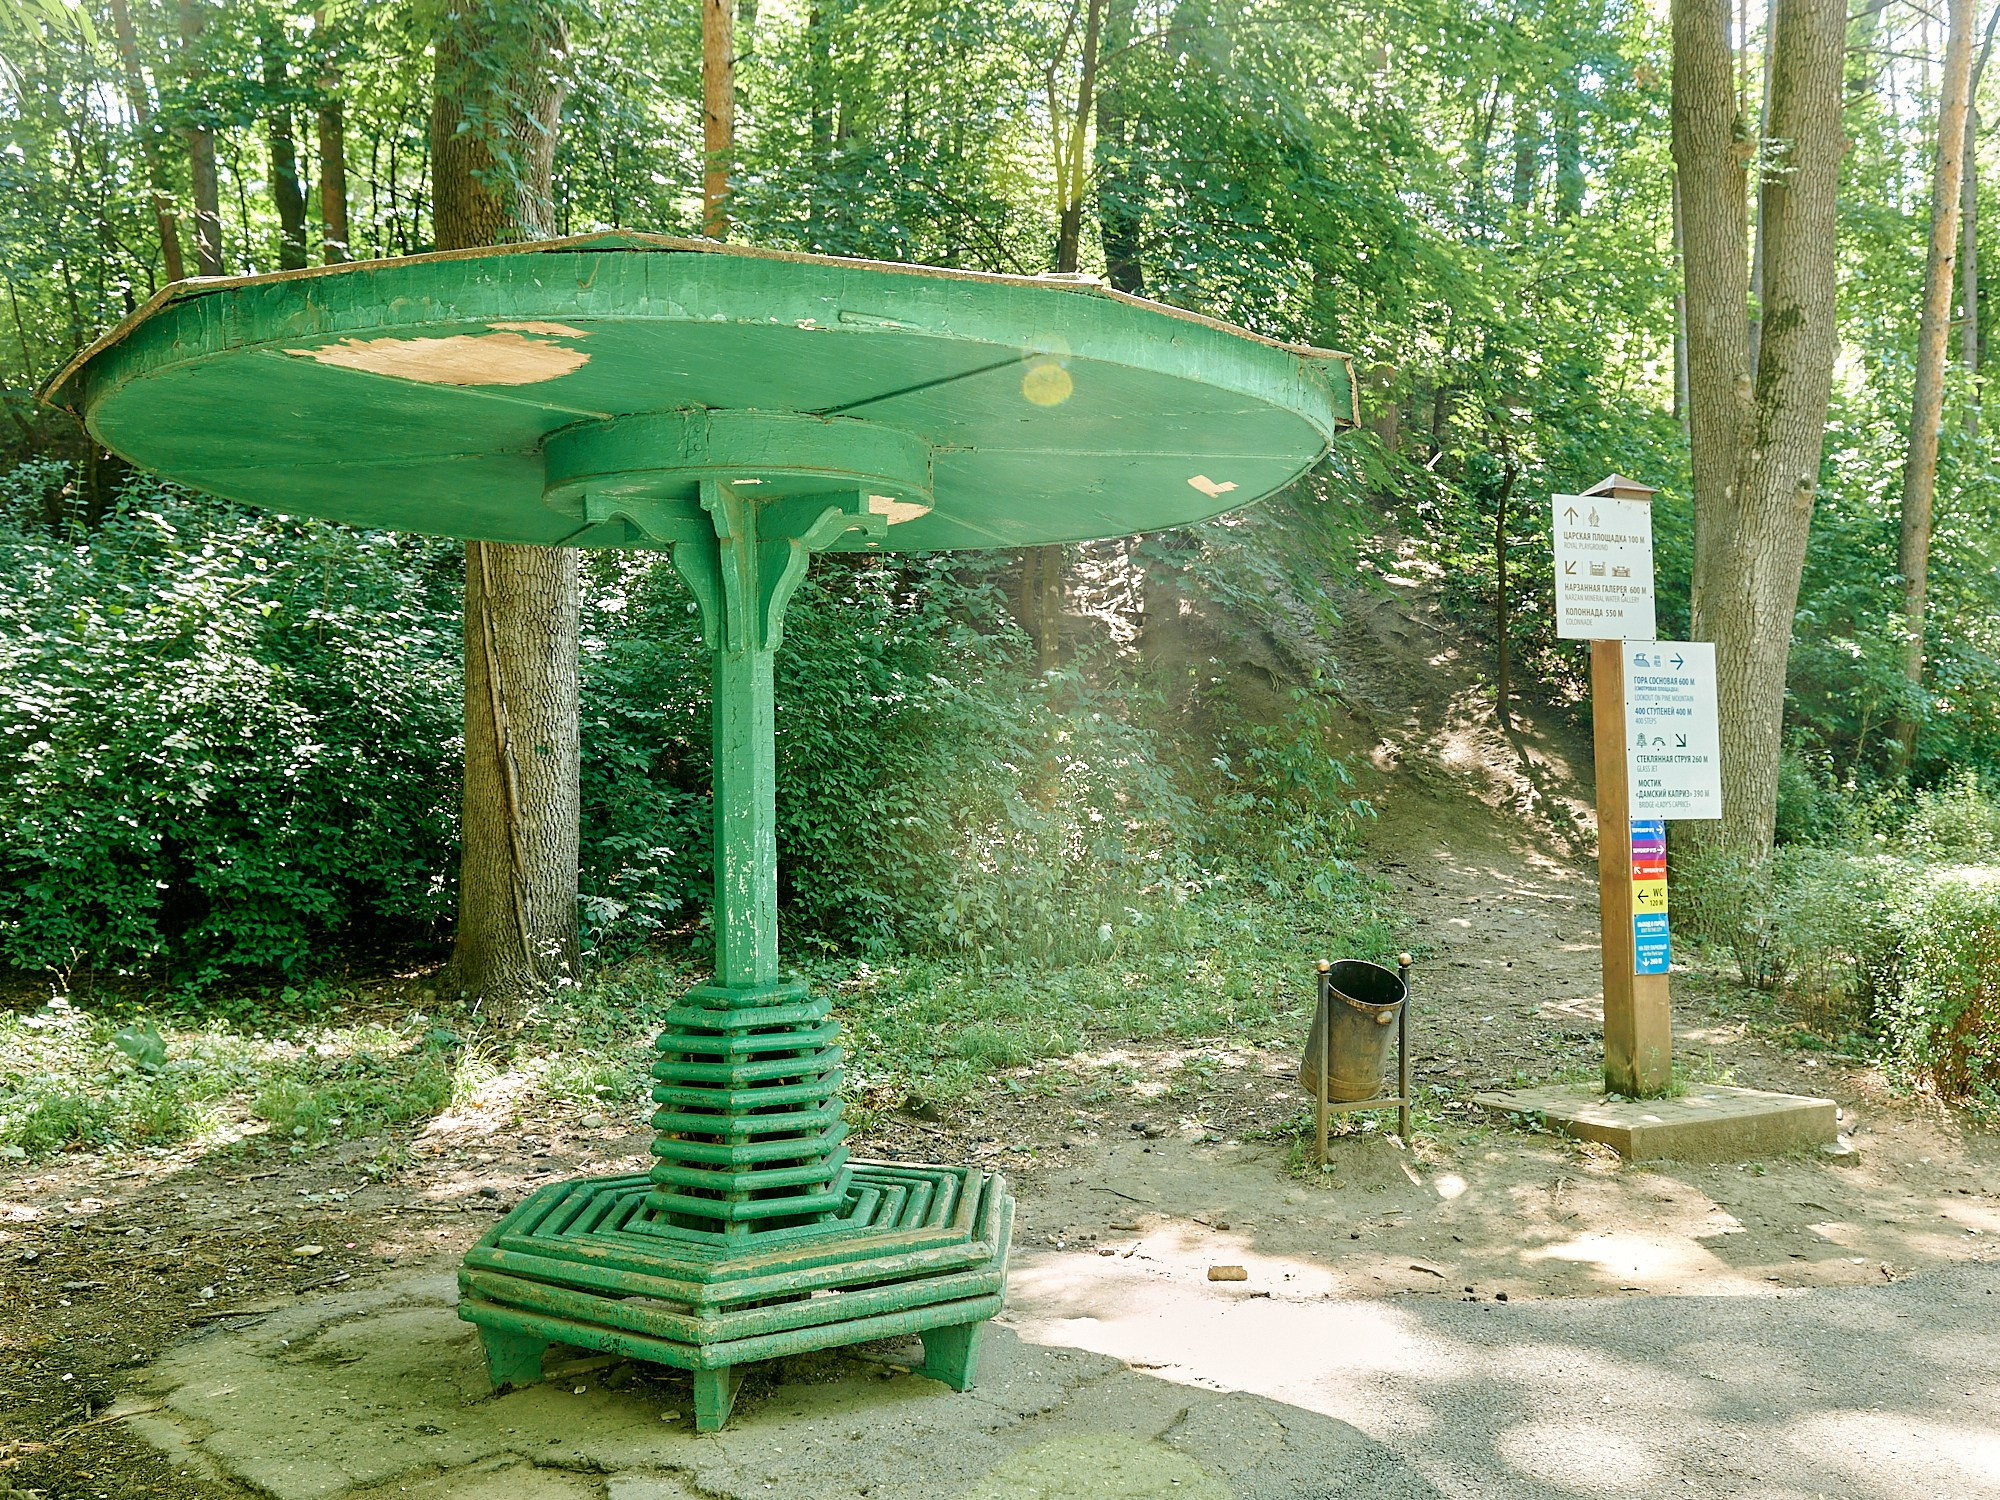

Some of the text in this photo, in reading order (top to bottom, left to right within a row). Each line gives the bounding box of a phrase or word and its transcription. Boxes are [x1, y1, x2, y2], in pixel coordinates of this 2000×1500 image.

[1564, 531, 1591, 540] ЦАРСКАЯ
[1592, 533, 1627, 543] ПЛОЩАДКА
[1629, 535, 1639, 543] 100
[1579, 543, 1609, 551] PLAYGROUND
[1564, 583, 1601, 592] НАРЗАННАЯ
[1602, 585, 1627, 593] ГАЛЕРЕЯ
[1630, 586, 1640, 594] 600
[1565, 607, 1603, 617] КОЛОННАДА
[1605, 609, 1616, 617] 550
[1566, 618, 1593, 626] COLONNADE
[1634, 676, 1648, 685] ГОРА
[1649, 677, 1678, 685] СОСНОВАЯ
[1679, 678, 1689, 686] 600
[1635, 707, 1645, 715] 400
[1647, 706, 1675, 715] СТУПЕНЕЙ
[1676, 708, 1686, 716] 400
[1636, 755, 1673, 763] СТЕКЛЯННАЯ
[1674, 755, 1691, 763] СТРУЯ
[1692, 755, 1702, 763] 260
[1638, 779, 1662, 787] МОСТИК
[1636, 789, 1667, 799] «ДАМСКИЙ
[1668, 790, 1693, 798] КАПРИЗ»
[1653, 888, 1663, 897] WC
